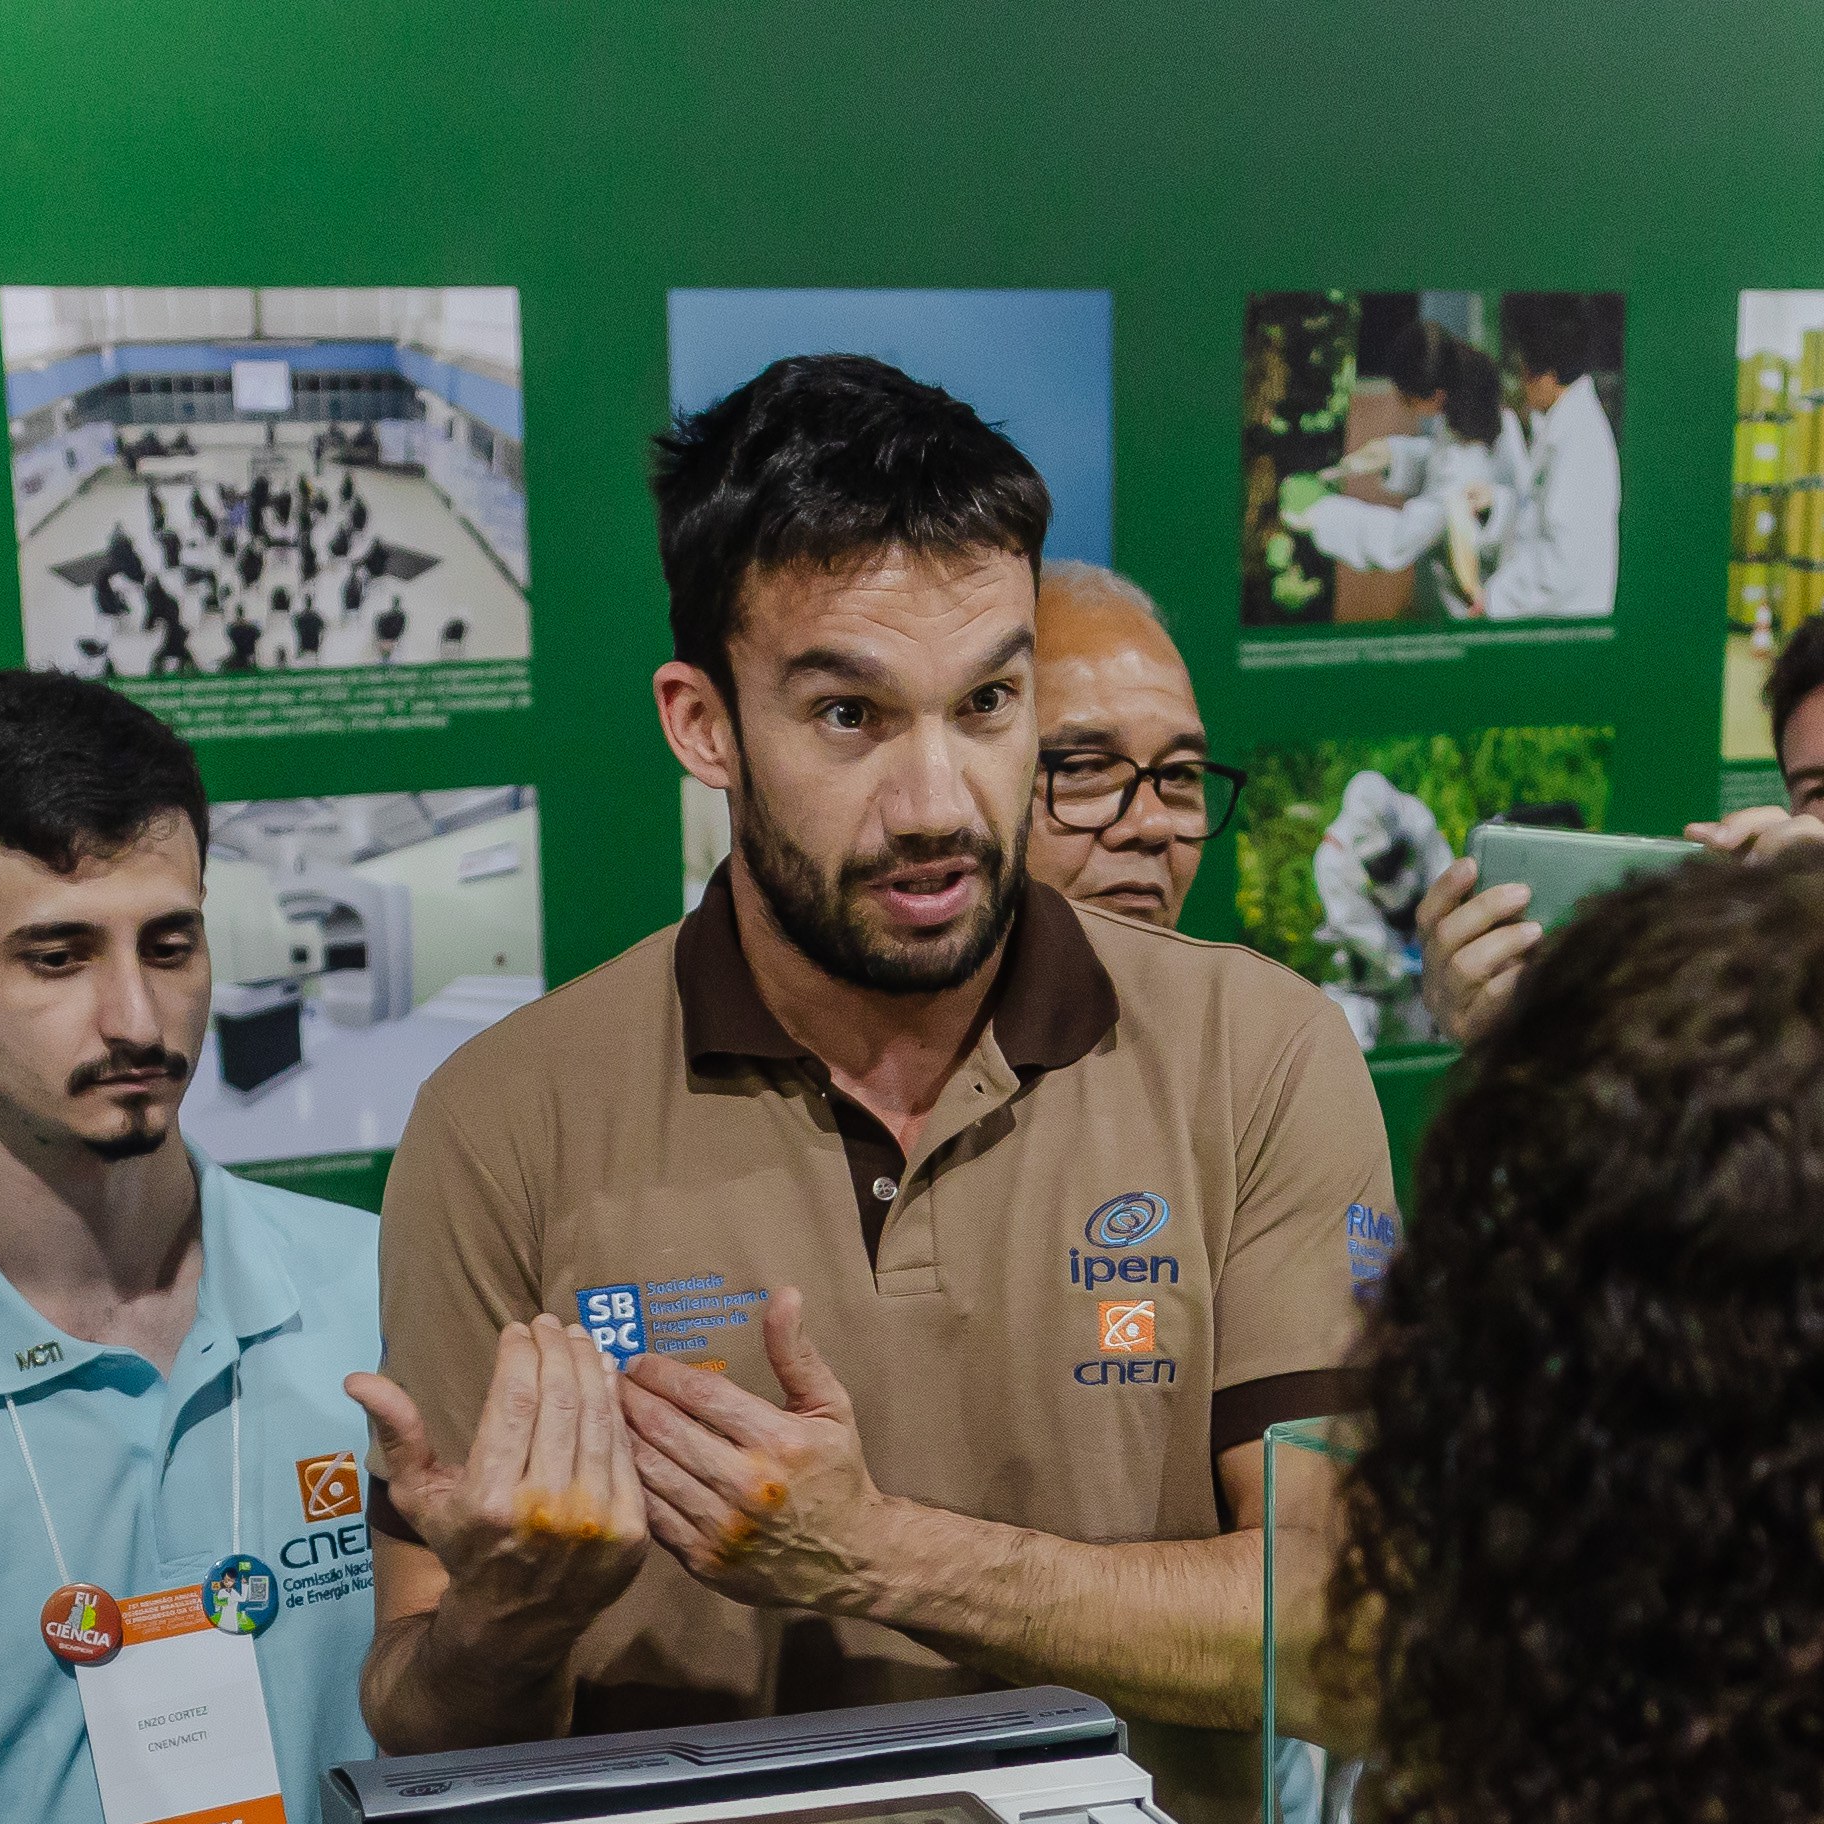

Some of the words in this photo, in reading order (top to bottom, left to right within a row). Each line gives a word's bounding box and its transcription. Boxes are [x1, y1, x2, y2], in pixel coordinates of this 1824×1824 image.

[1069, 1248, 1179, 1291] ipen
[646, 1274, 724, 1296] Sociedade
[588, 1292, 636, 1323] SB
[649, 1296, 720, 1315] Brasileira
[723, 1291, 755, 1310] para
[758, 1289, 769, 1300] o
[652, 1315, 726, 1334] Progresso
[591, 1323, 640, 1353] PC
[1073, 1359, 1176, 1386] CNEN
[283, 1568, 343, 1592] Comissão
[286, 1594, 304, 1608] de
[307, 1581, 350, 1604] Energia
[45, 1621, 111, 1648] CIÊNCIA
[138, 1716, 166, 1730] ENZO
[168, 1705, 208, 1722] CORTEZ
[148, 1731, 207, 1752] CNEN/MCTI
